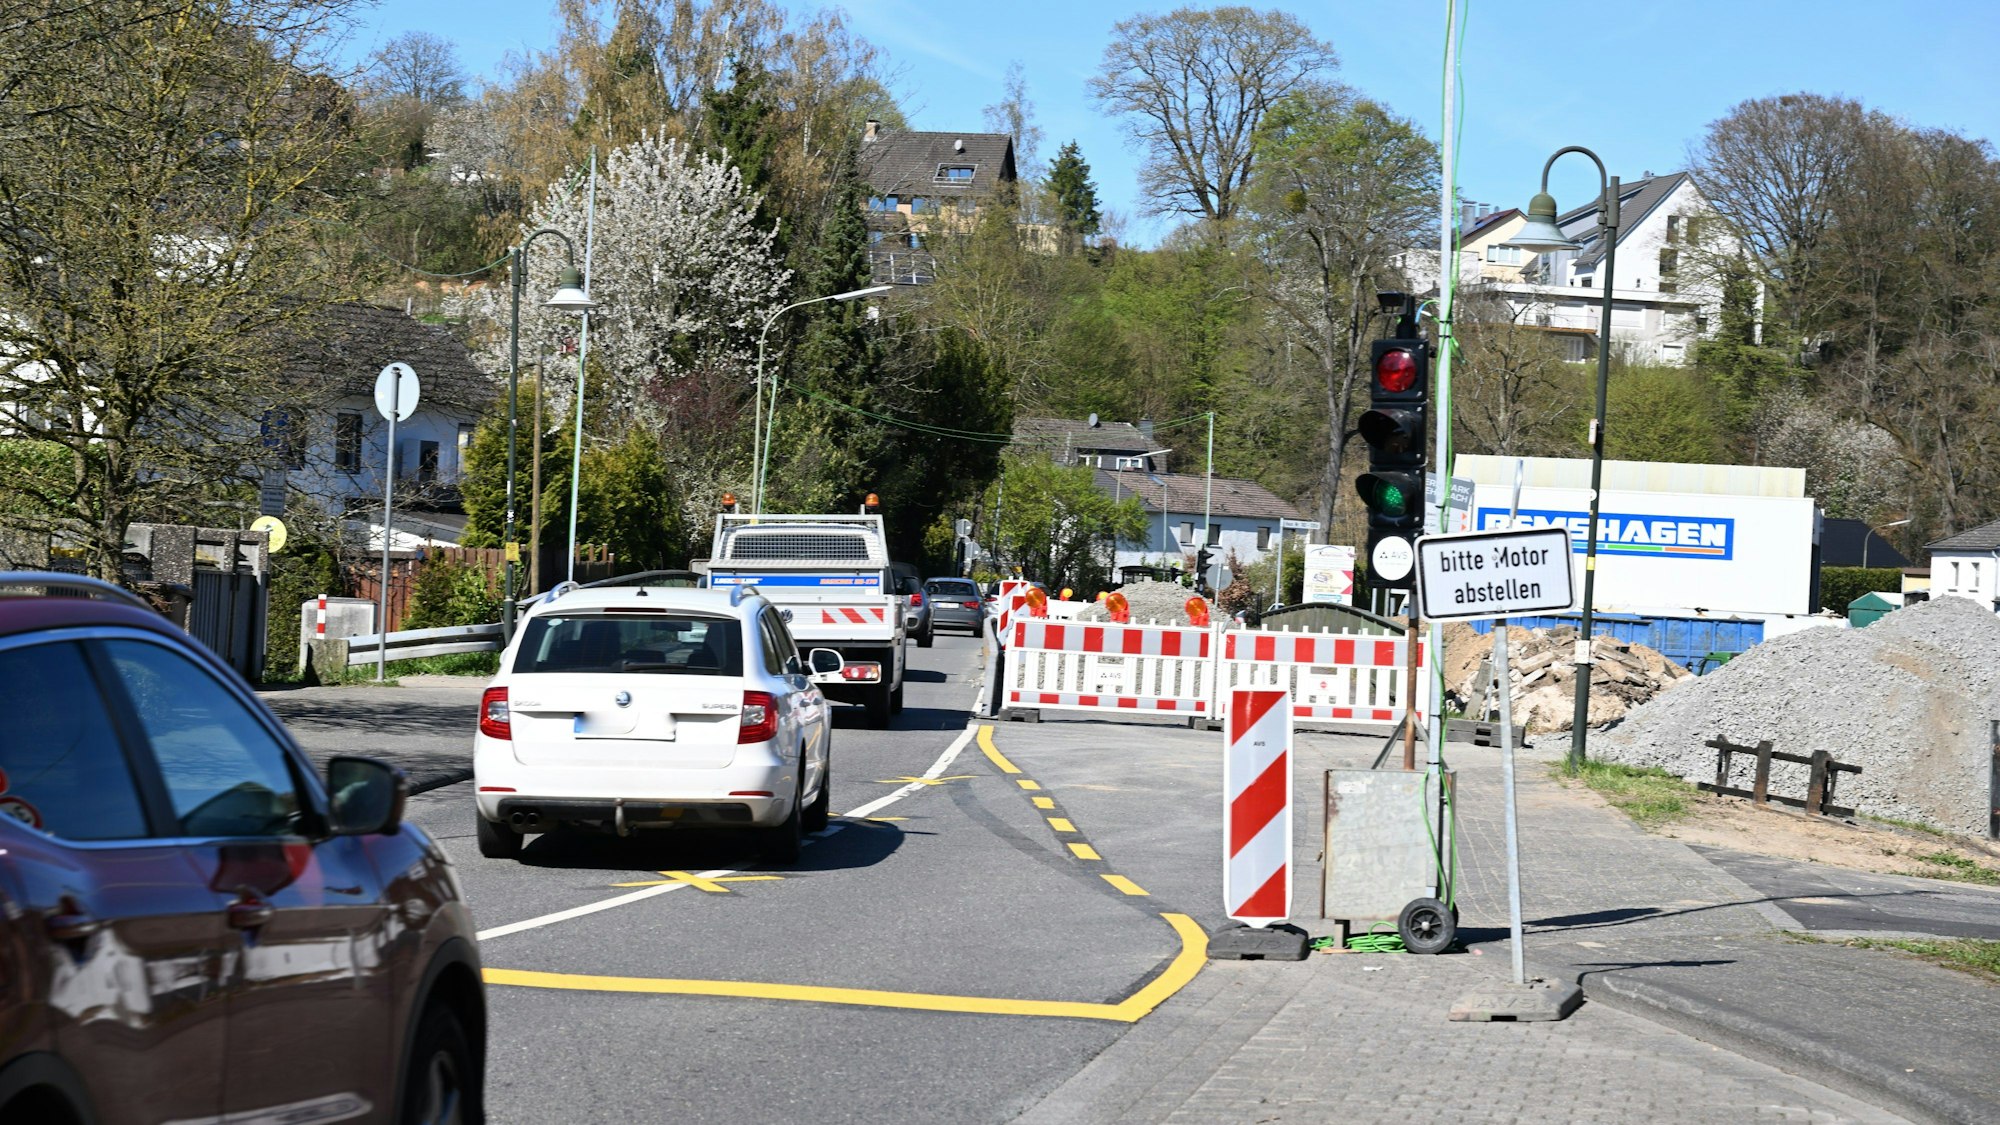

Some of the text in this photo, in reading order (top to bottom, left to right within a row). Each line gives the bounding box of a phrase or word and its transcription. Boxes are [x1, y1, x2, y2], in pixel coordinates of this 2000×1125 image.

[1440, 546, 1549, 573] bitte Motor
[1454, 578, 1542, 604] abstellen
